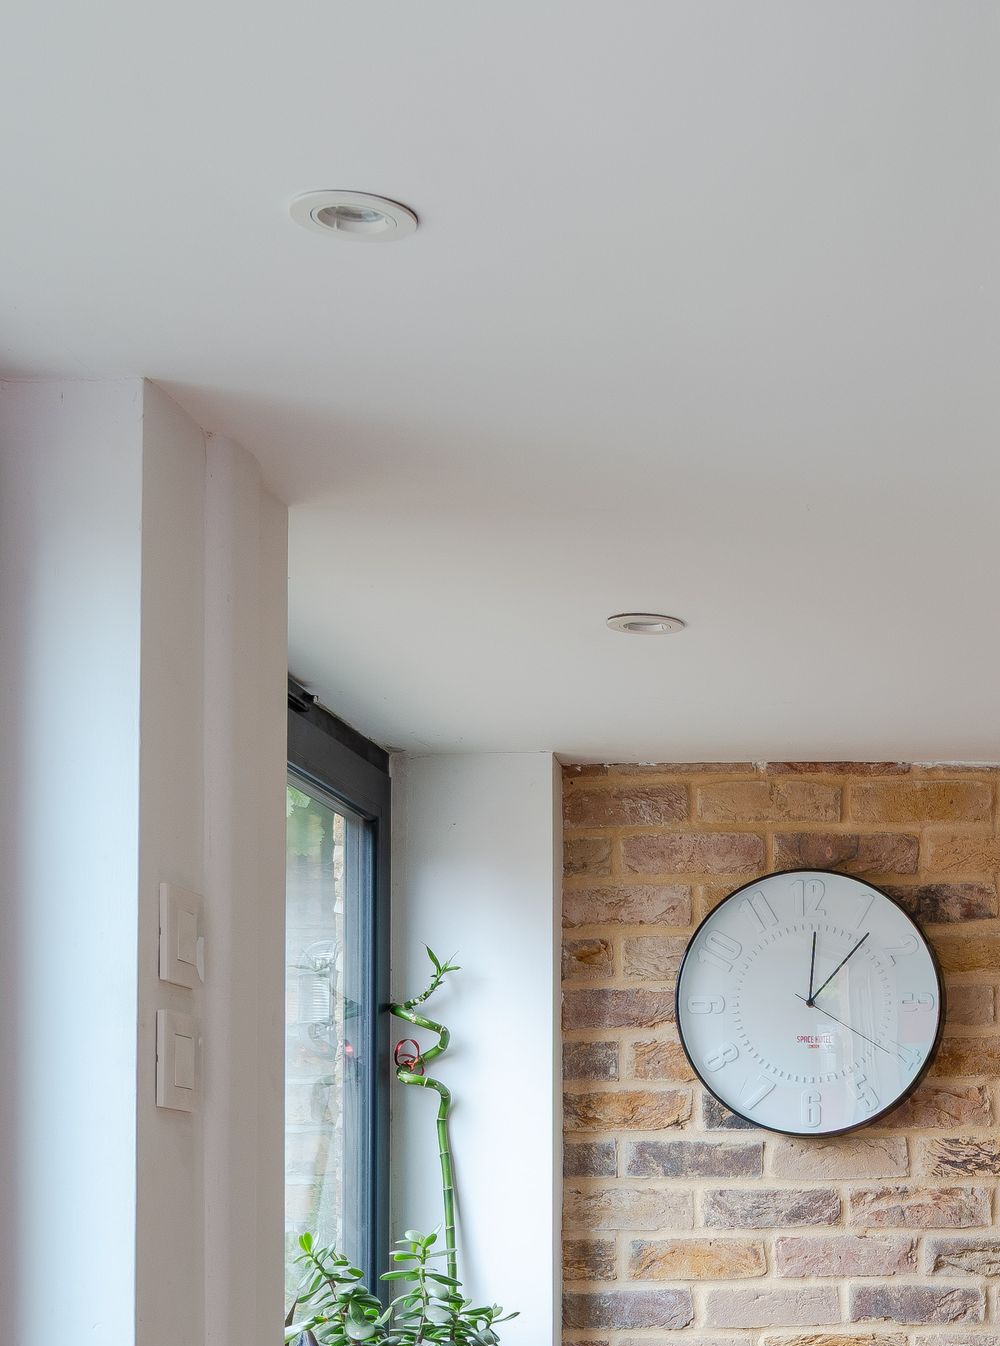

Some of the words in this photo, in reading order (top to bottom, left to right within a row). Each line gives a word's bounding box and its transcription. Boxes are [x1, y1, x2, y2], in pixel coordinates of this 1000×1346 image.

[739, 890, 779, 933] 11
[789, 878, 827, 917] 12
[697, 929, 743, 974] 10
[886, 934, 920, 968] 2
[687, 994, 726, 1015] 9
[901, 991, 935, 1014] 3
[796, 1035, 814, 1043] SPACE
[891, 1040, 922, 1072] 4
[703, 1042, 740, 1073] 8
[736, 1074, 777, 1112] 7
[800, 1089, 822, 1129] 6
[849, 1074, 880, 1113] 5
